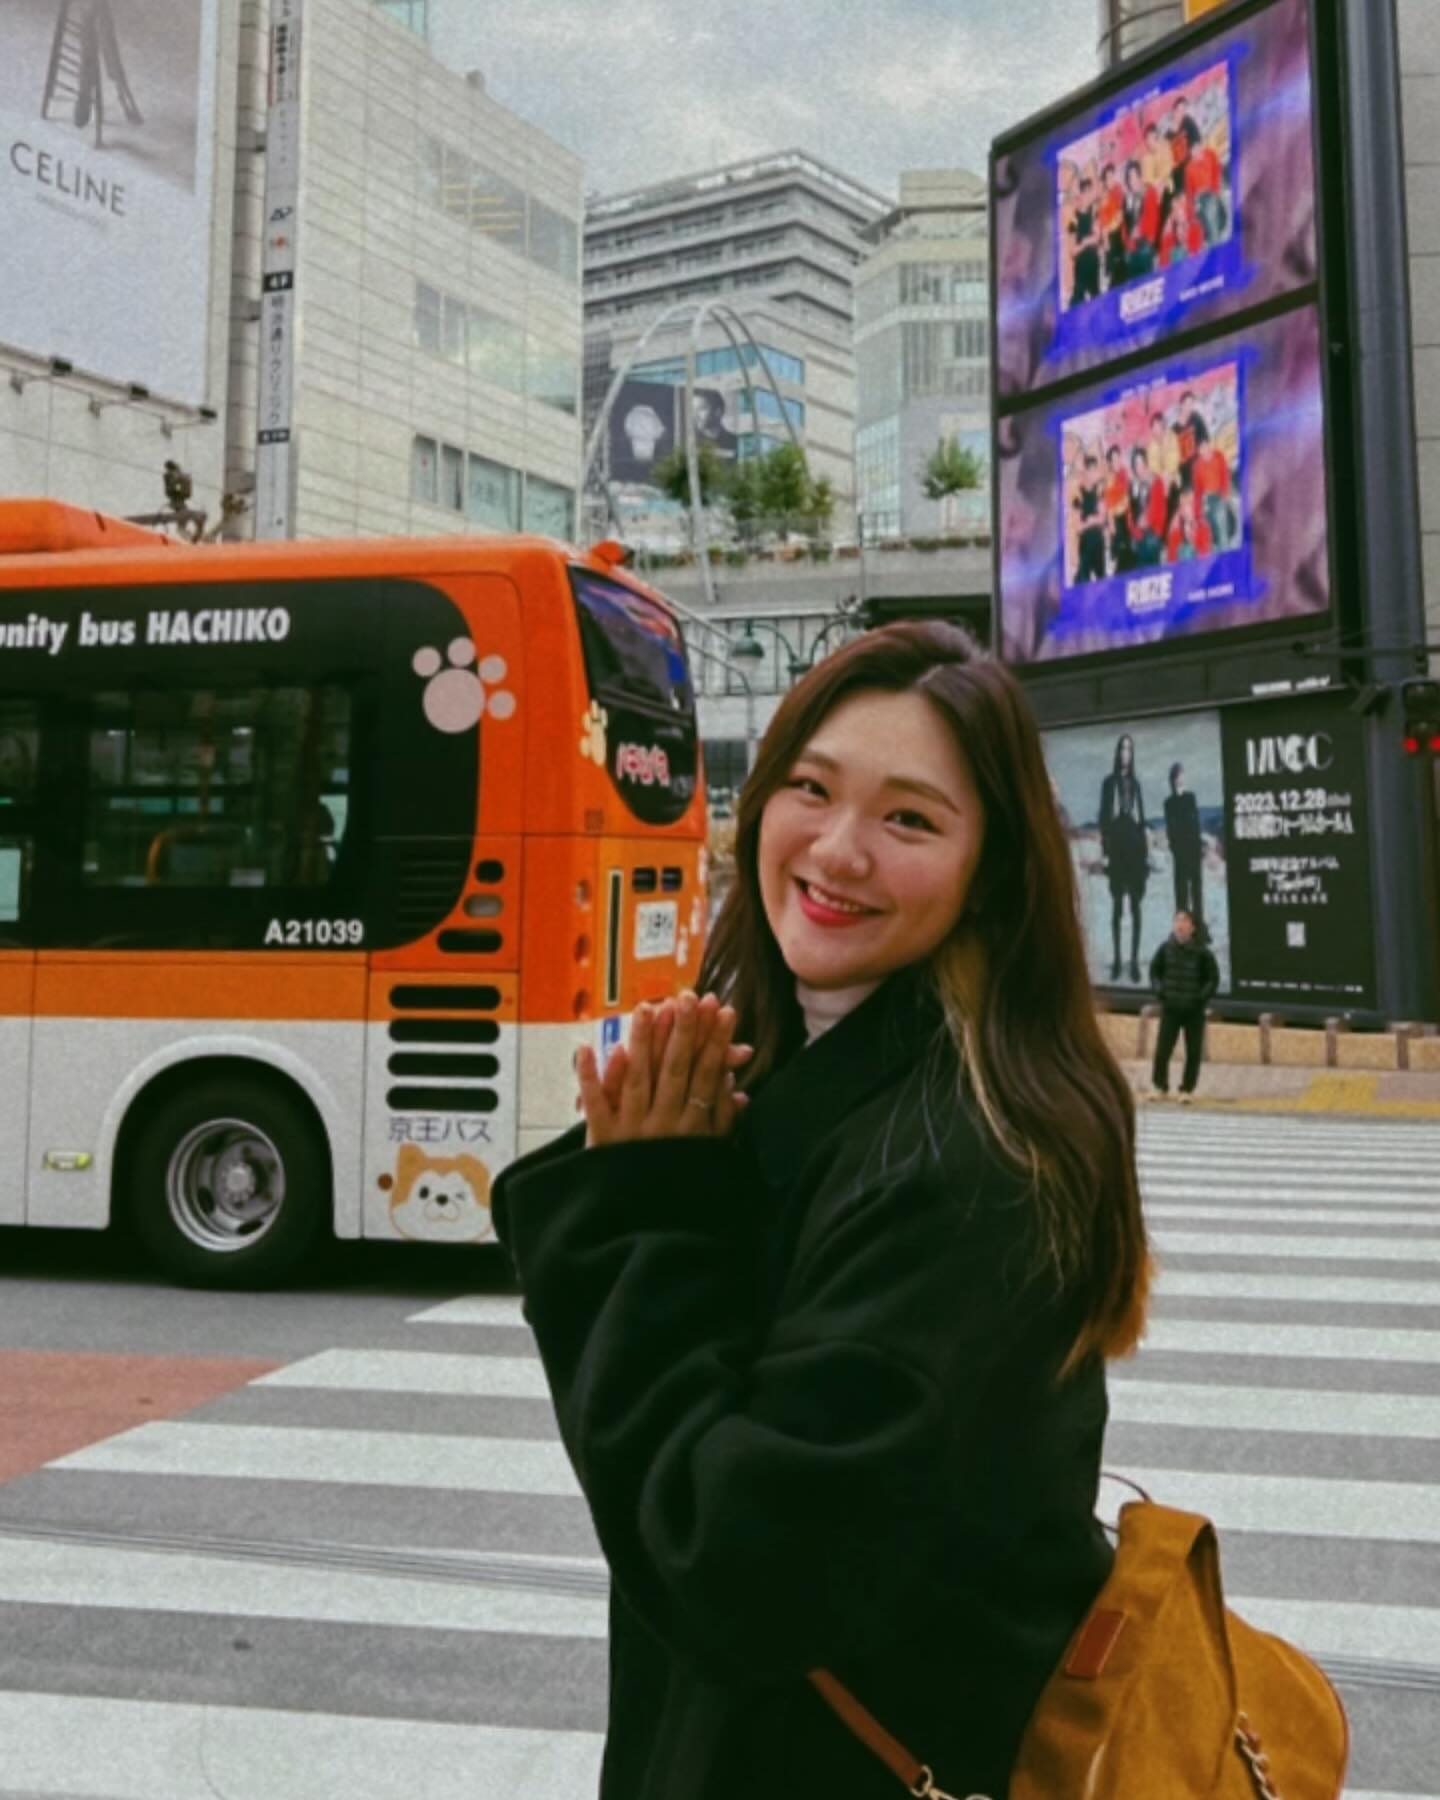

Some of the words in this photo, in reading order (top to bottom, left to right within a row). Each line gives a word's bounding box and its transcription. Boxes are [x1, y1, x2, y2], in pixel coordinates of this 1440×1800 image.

[9, 139, 127, 217] CELINE
[0, 613, 68, 654] nity
[78, 611, 137, 646] bus
[146, 607, 291, 645] HACHIKO
[264, 917, 364, 945] A21039
[388, 1115, 493, 1142] 京王バス
